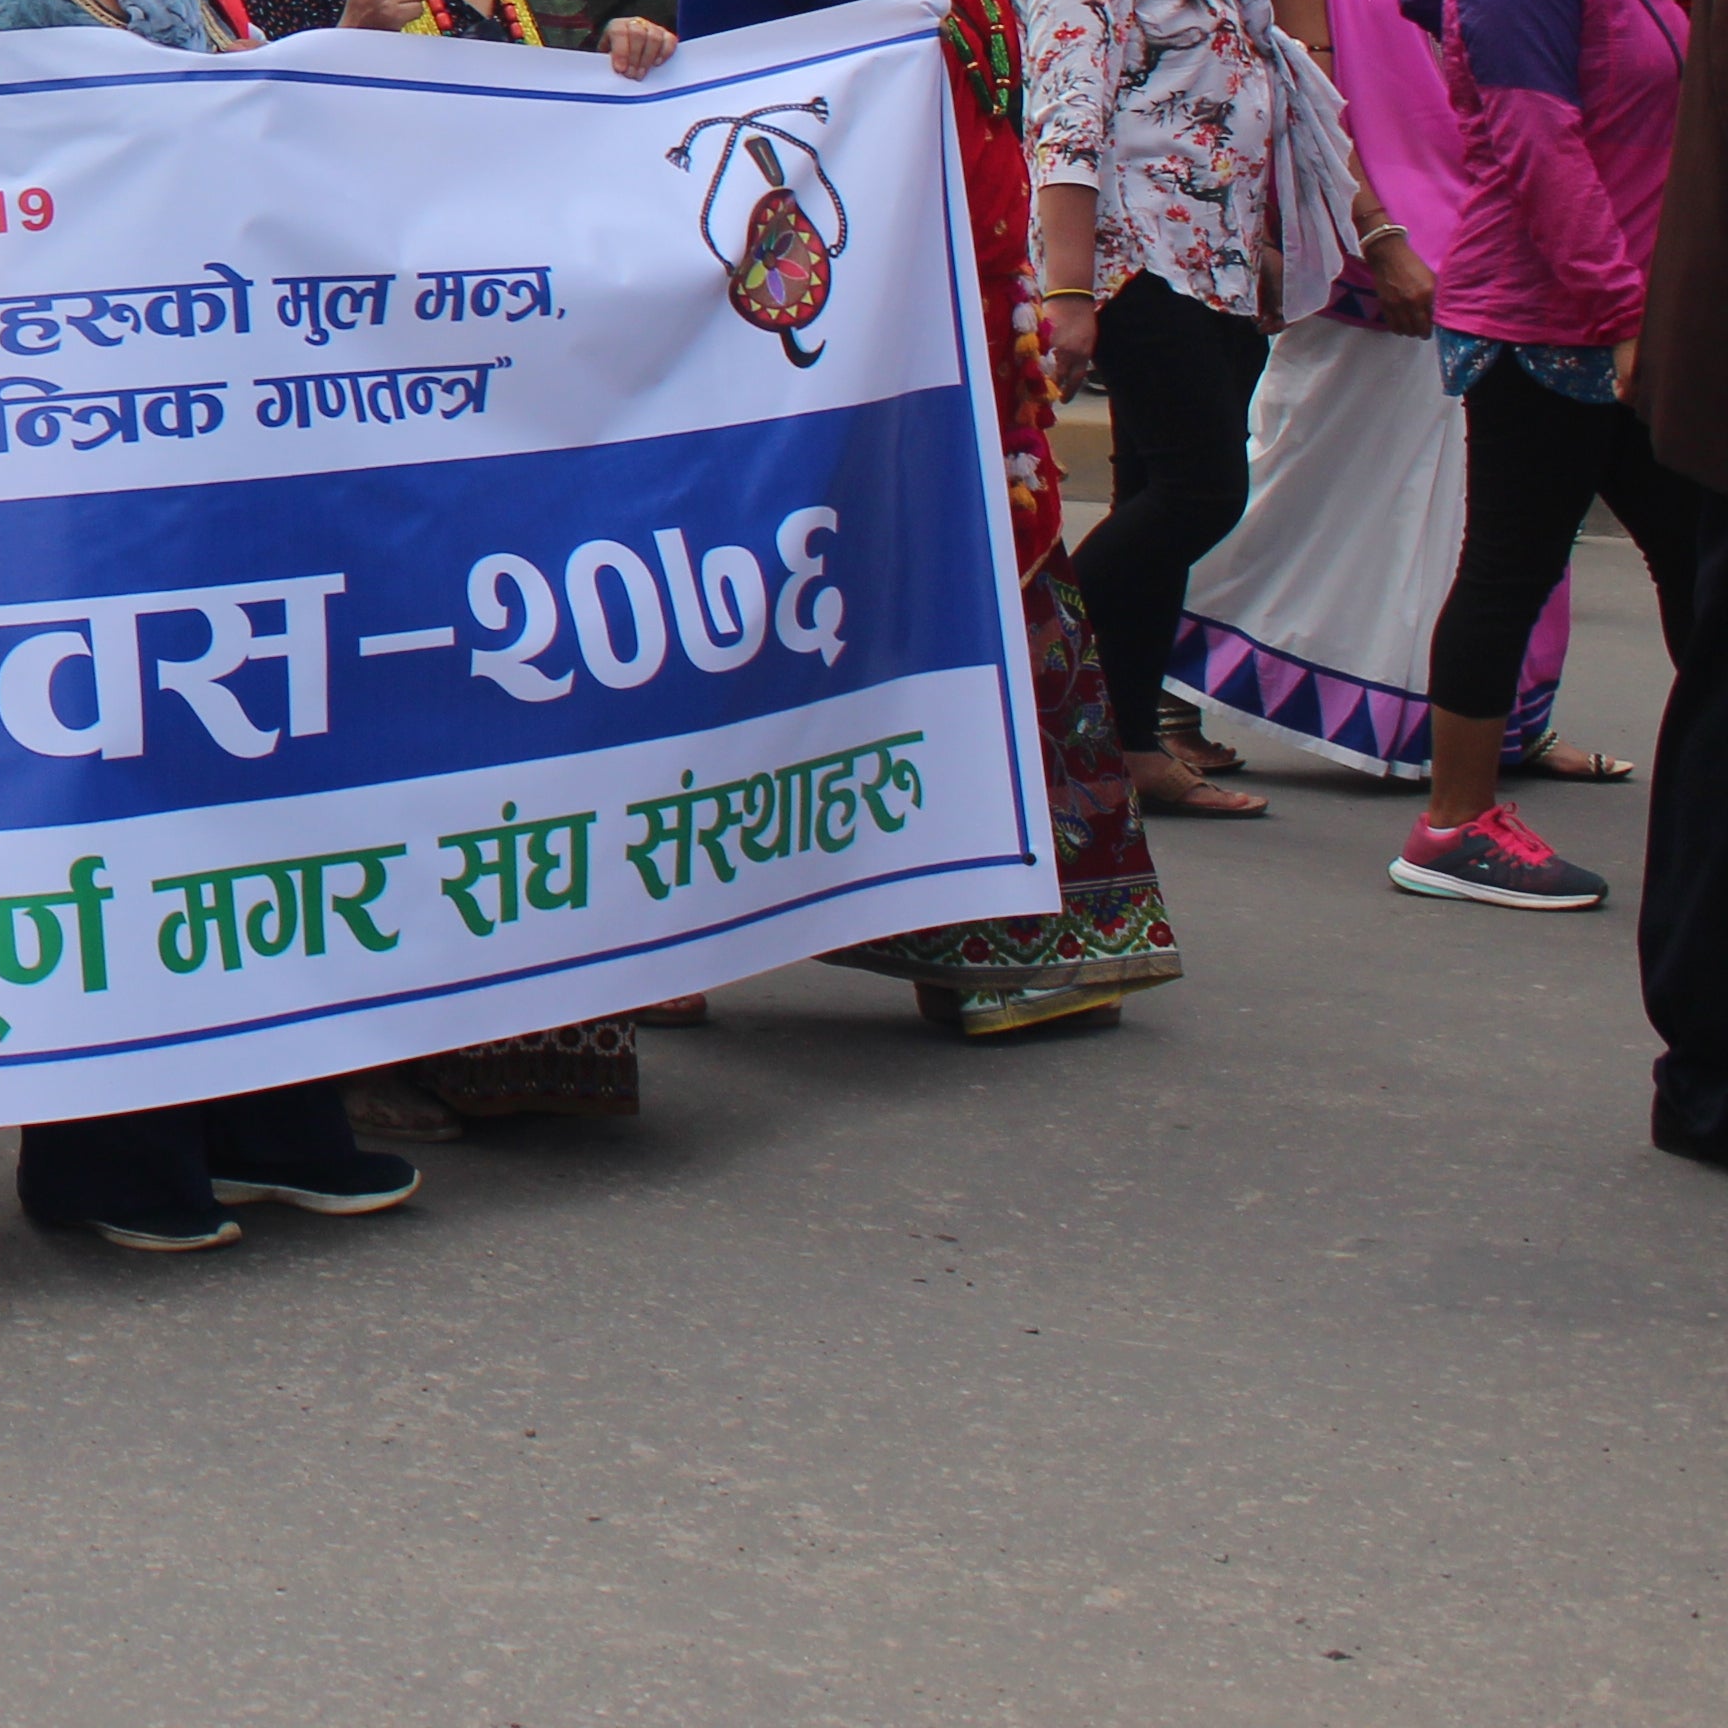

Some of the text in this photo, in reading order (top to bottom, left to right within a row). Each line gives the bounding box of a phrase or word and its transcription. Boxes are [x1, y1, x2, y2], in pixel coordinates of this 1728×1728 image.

[271, 272, 397, 347] मुल
[152, 842, 408, 976] मगर
[439, 801, 598, 938] संघ
